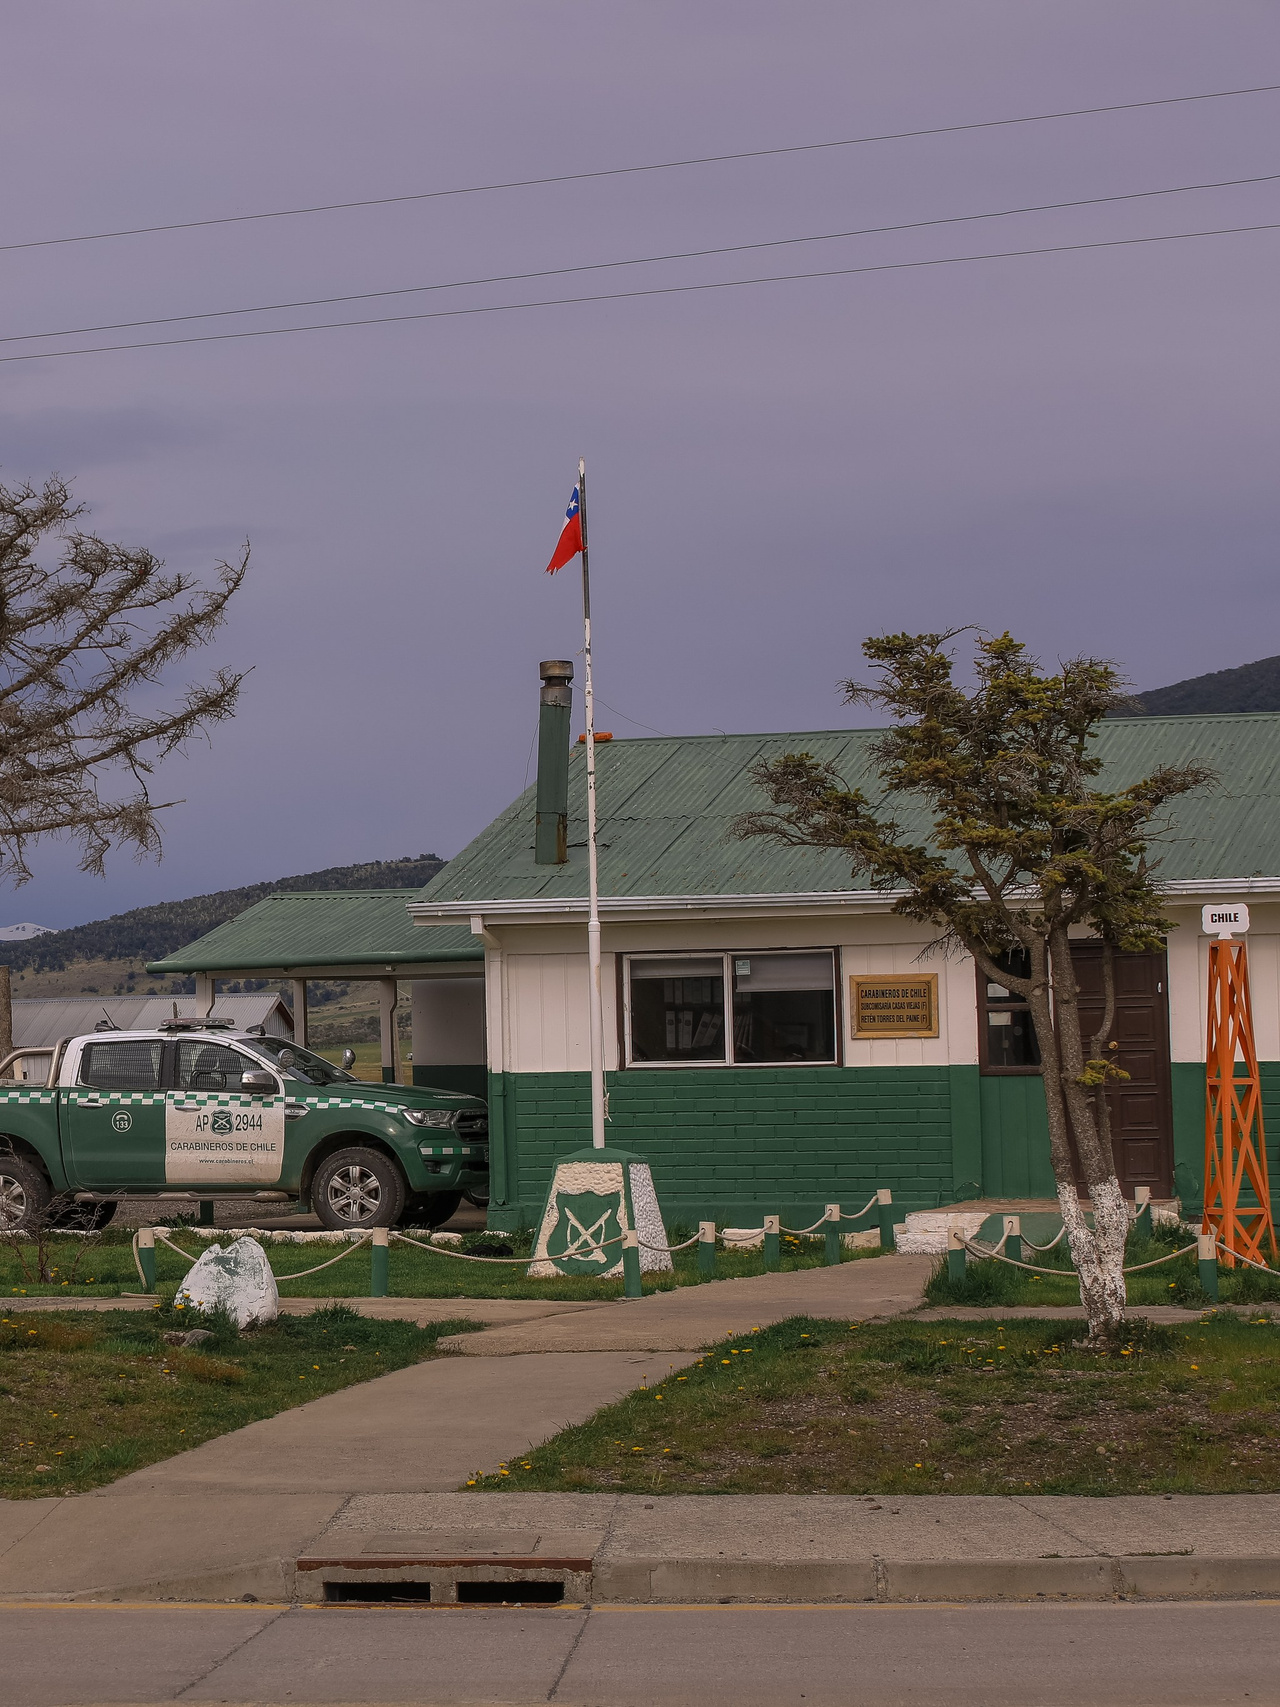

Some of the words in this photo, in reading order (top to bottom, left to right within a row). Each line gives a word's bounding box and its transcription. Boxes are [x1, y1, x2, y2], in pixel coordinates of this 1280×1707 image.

[1210, 912, 1239, 923] CHILE
[860, 989, 900, 998] CARABINEROS
[901, 989, 909, 997] DE
[910, 989, 926, 997] CHILE
[892, 1002, 906, 1010] CASAS
[906, 1001, 920, 1009] VIEJAS
[860, 1014, 876, 1023] RETÉN
[877, 1015, 895, 1023] TORRES
[906, 1014, 920, 1022] PAINE
[116, 1120, 129, 1128] 133
[195, 1115, 209, 1131] AP
[235, 1114, 263, 1131] 2944
[170, 1142, 233, 1151] CARABINEROS
[236, 1142, 248, 1151] DE
[250, 1142, 276, 1151] CHILE
